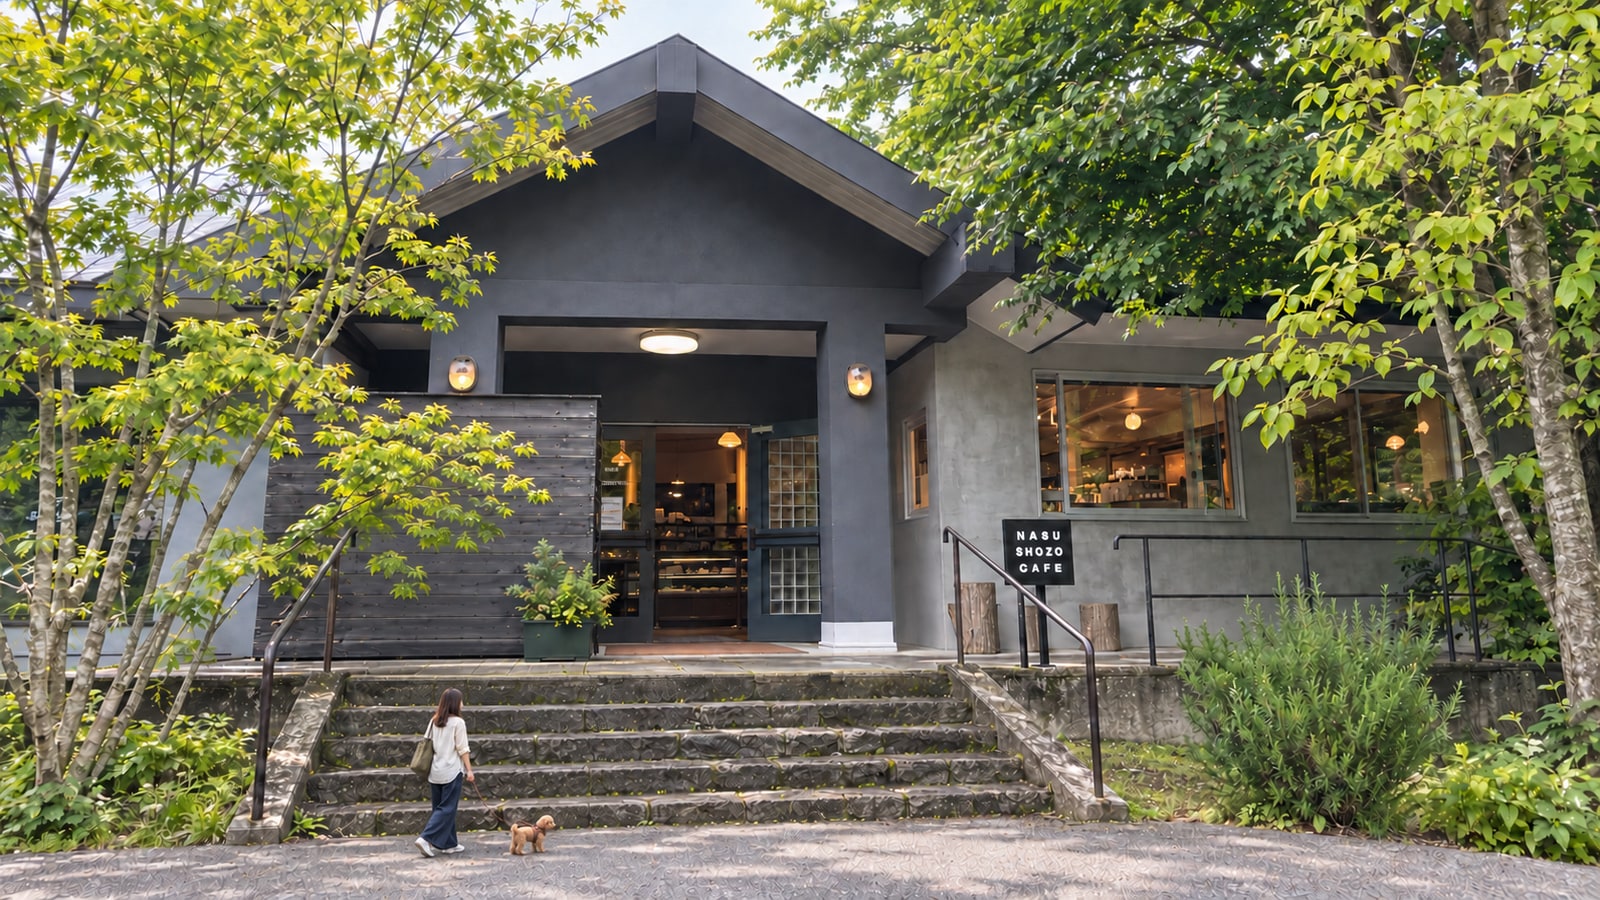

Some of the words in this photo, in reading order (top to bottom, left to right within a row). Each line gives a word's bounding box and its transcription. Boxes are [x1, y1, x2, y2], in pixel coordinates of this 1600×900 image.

[1016, 531, 1061, 541] NASU
[1015, 547, 1064, 557] SHOZO
[1019, 563, 1063, 573] CAFE
